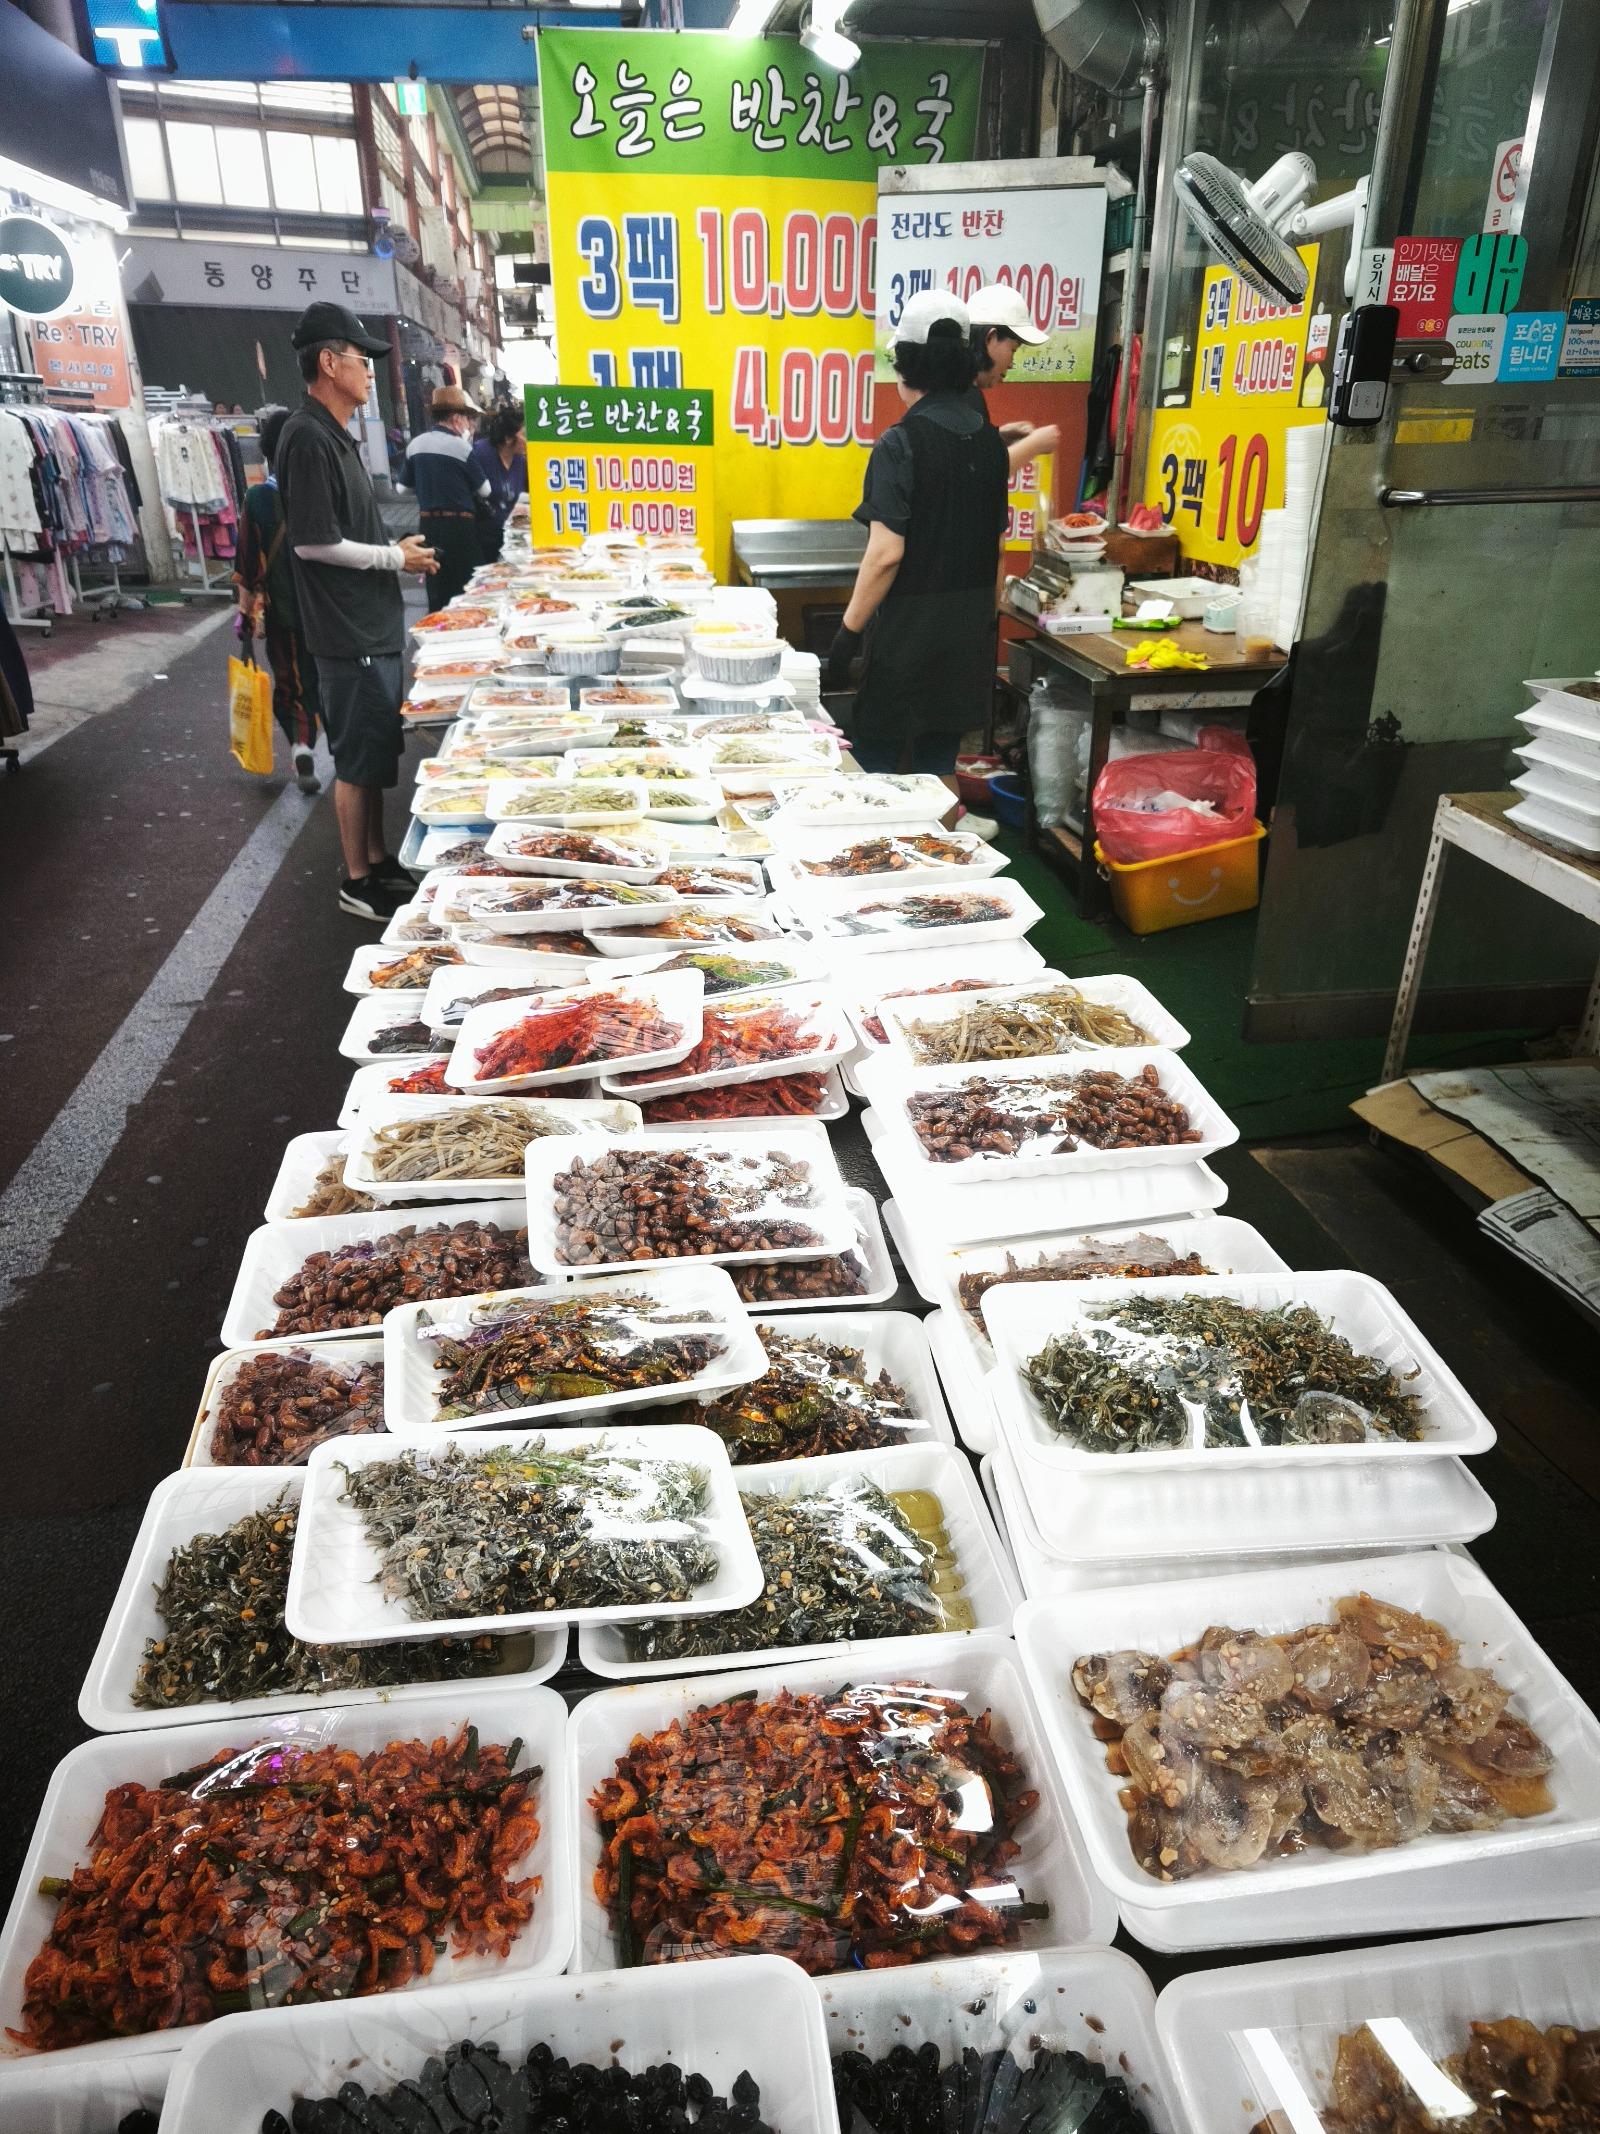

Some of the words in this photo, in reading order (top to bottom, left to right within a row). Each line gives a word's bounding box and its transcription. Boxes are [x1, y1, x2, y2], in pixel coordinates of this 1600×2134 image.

[572, 61, 703, 157] 오늘은
[891, 210, 952, 240] 전라도
[962, 209, 1004, 238] 반찬
[581, 216, 677, 318] 3팩
[1400, 243, 1458, 262] 인기맛집
[1395, 263, 1440, 282] 배달은
[1206, 278, 1233, 328] 3팩
[1392, 284, 1437, 302] 요기요
[1202, 346, 1225, 393] 1팩
[1234, 340, 1298, 392] 4,000원
[1453, 352, 1490, 370] eats
[1510, 345, 1552, 365] 됩니다
[538, 396, 594, 435] 오늘은
[549, 458, 585, 490] 3팩
[596, 457, 693, 490] 10,000원
[1159, 453, 1208, 528] 3팩
[553, 502, 587, 533] 1팩
